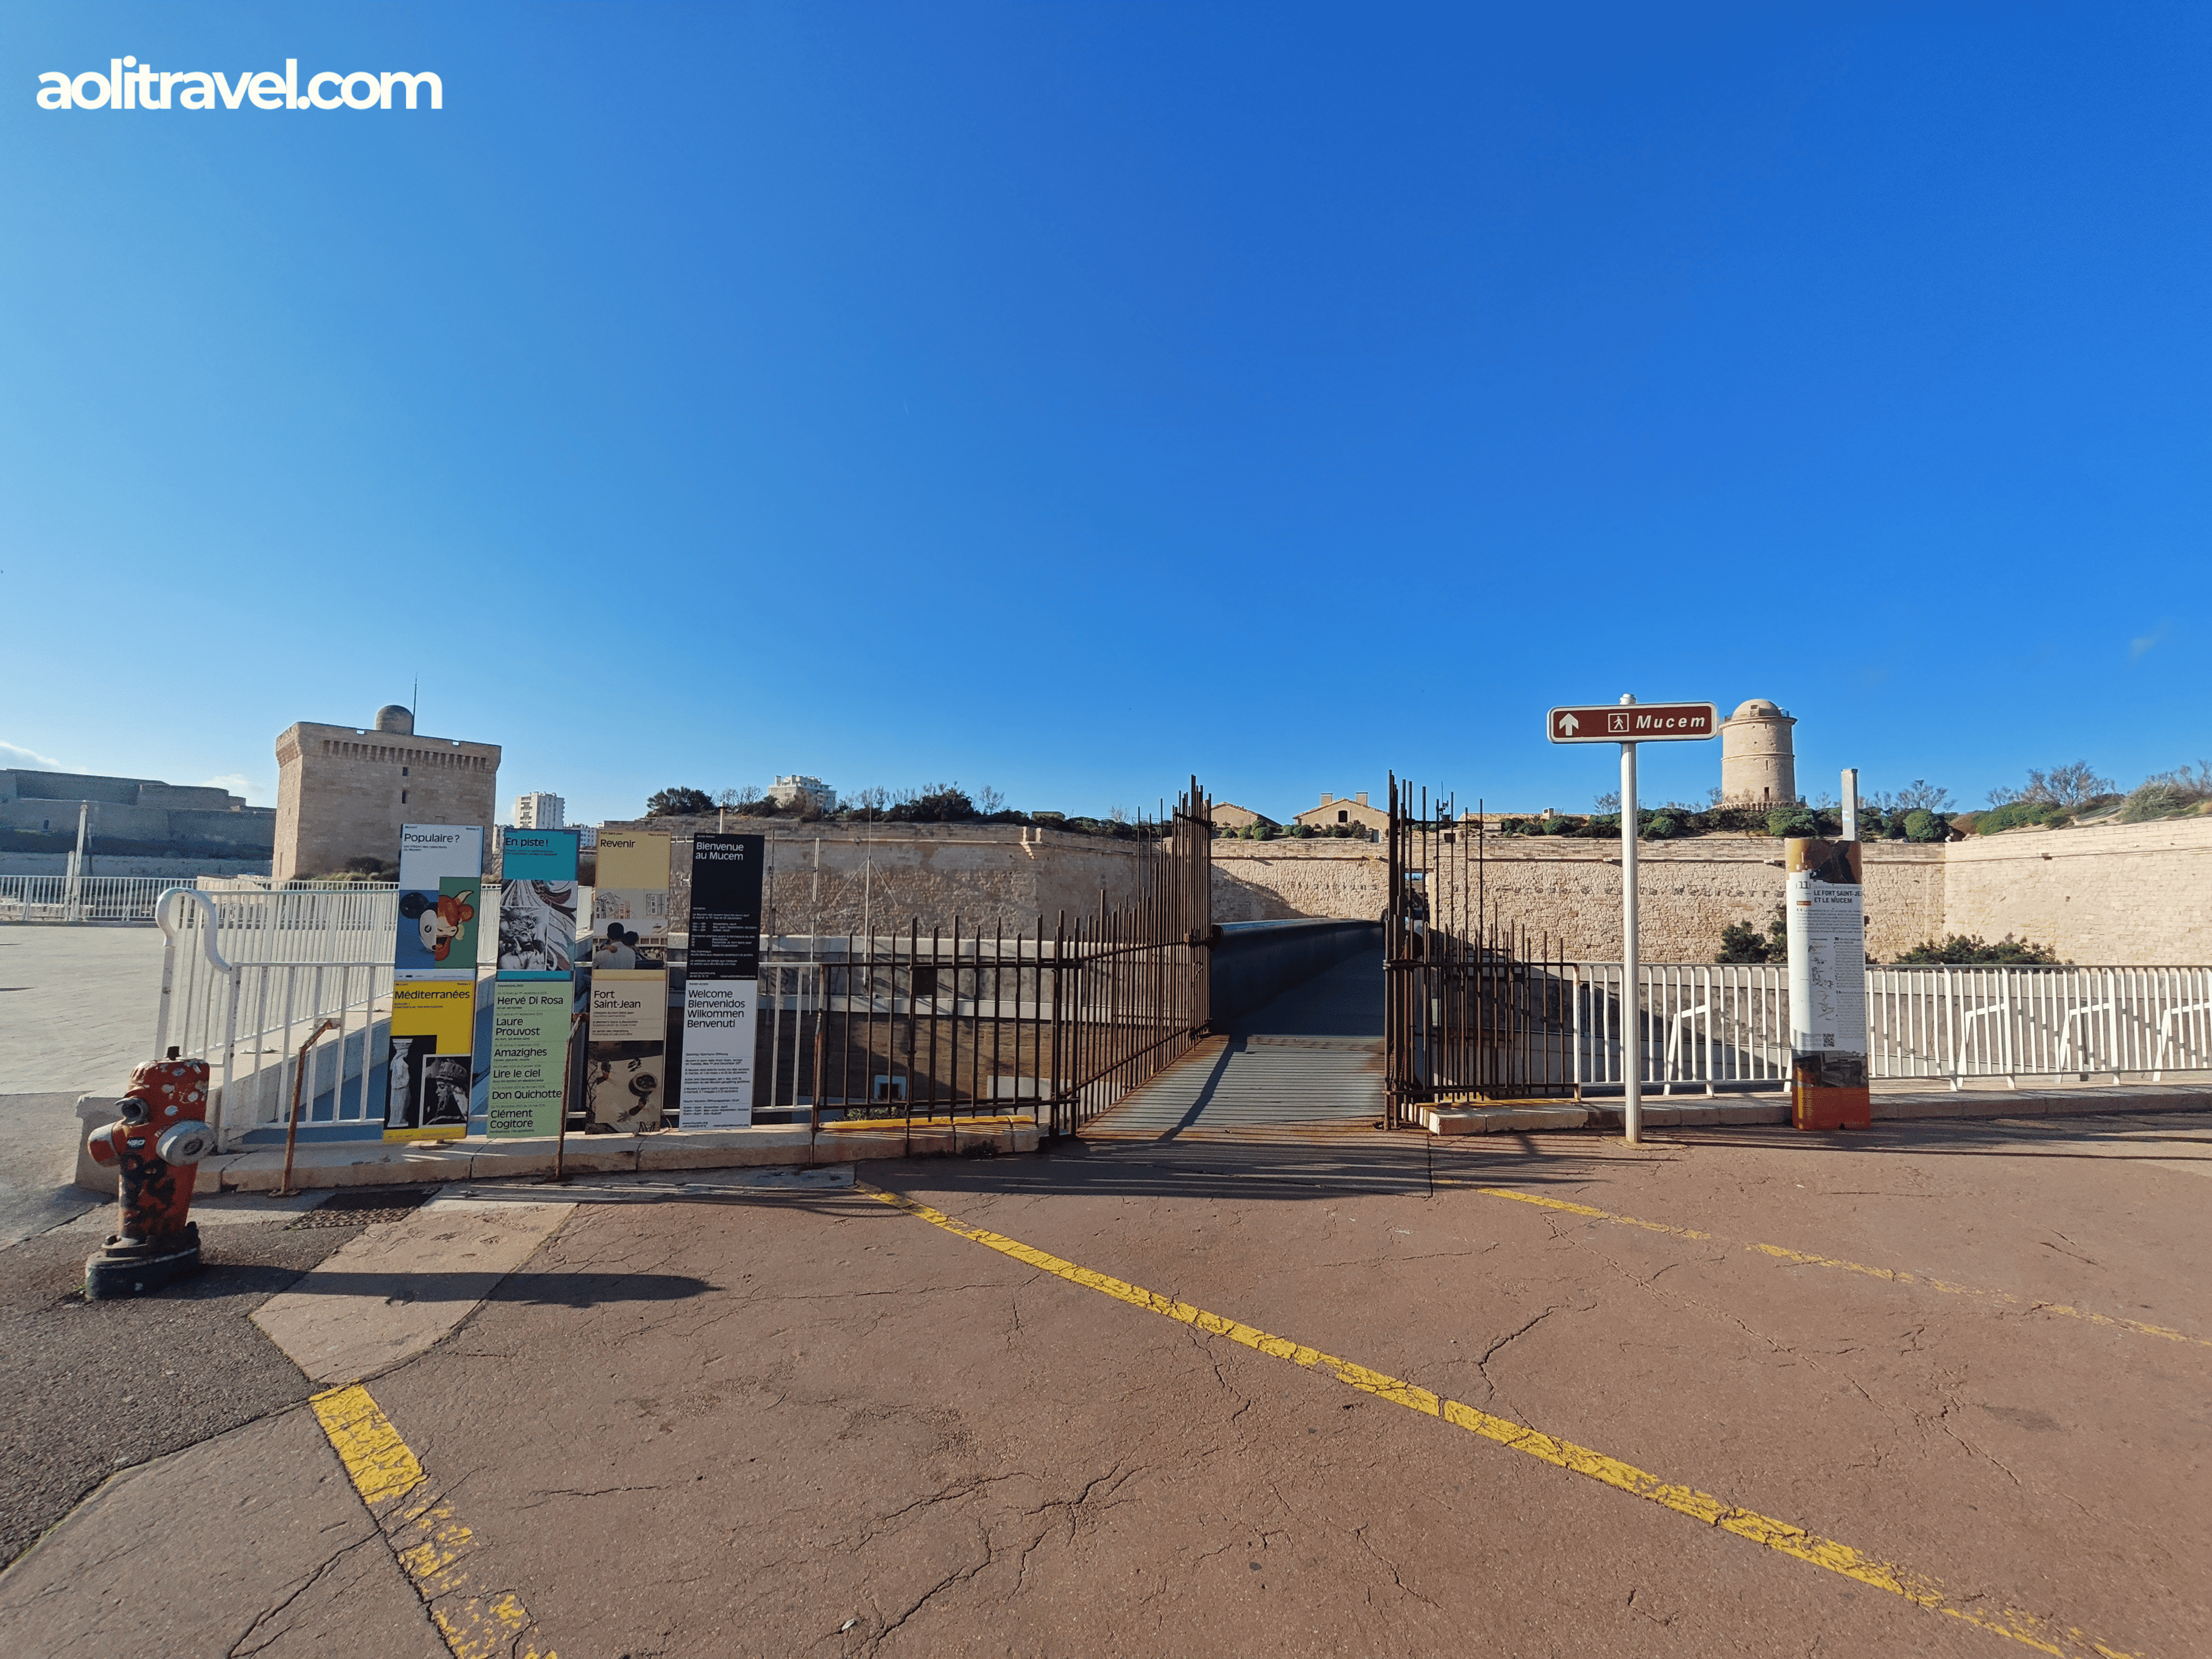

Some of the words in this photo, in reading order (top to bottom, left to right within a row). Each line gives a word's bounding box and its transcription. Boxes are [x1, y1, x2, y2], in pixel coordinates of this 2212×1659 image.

[1636, 715, 1705, 729] Mucem
[505, 837, 518, 846] En
[600, 839, 636, 848] Revenir
[696, 842, 744, 851] Bienvenue
[709, 852, 744, 860] Mucem
[1799, 881, 1809, 889] 11
[394, 990, 470, 999] Méditerranées
[594, 990, 615, 999] Fort
[688, 989, 733, 998] Welcome
[497, 995, 526, 1004] Hervé
[529, 996, 538, 1004] Di
[594, 1000, 641, 1008] Saint-Jean
[688, 999, 745, 1008] Bienvenidos
[687, 1009, 744, 1018] Wilkommen
[496, 1018, 523, 1026] Laure
[687, 1019, 735, 1028] Benvenuti
[495, 1027, 540, 1036] Prouvost
[494, 1048, 547, 1057] Amazighes
[493, 1070, 511, 1078] Lire
[513, 1069, 522, 1078] le
[524, 1068, 541, 1077] ciel
[492, 1091, 512, 1099] Don
[514, 1089, 562, 1099] Quichotte
[491, 1109, 533, 1118] Clément
[490, 1119, 533, 1129] Cogitore
